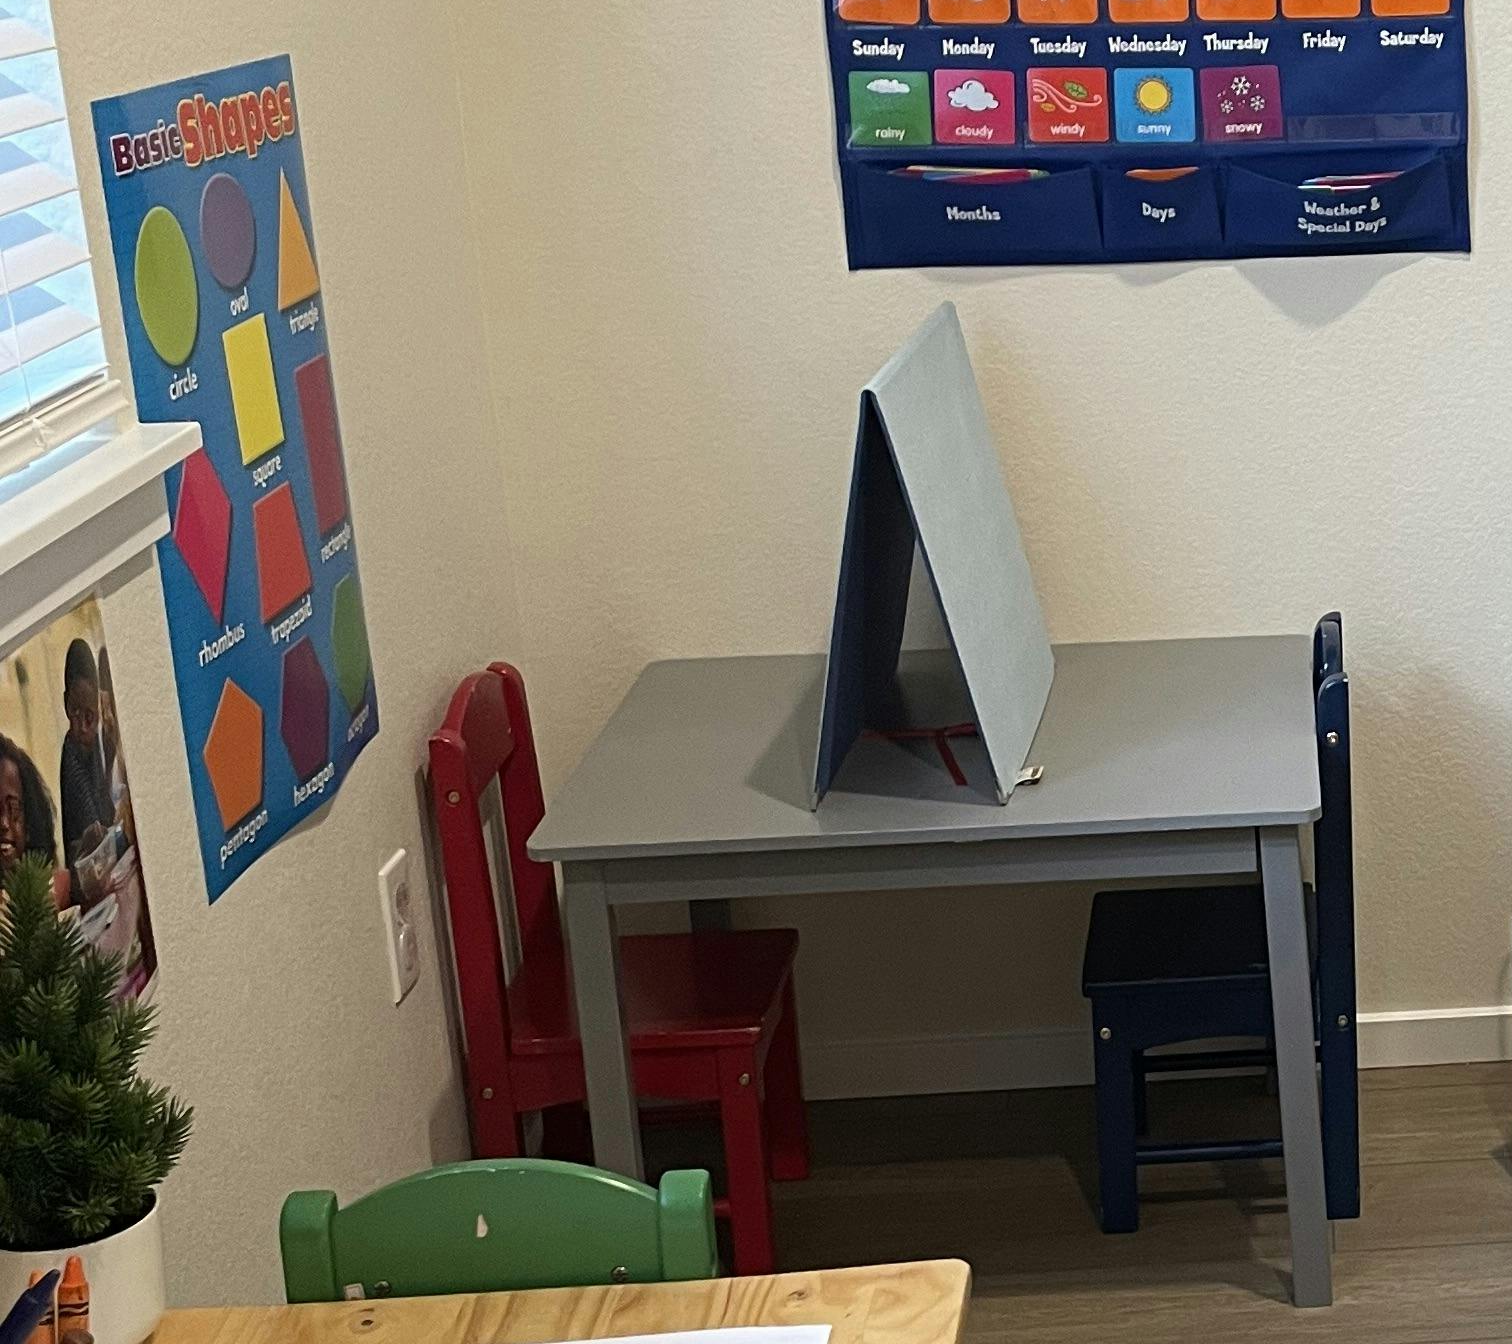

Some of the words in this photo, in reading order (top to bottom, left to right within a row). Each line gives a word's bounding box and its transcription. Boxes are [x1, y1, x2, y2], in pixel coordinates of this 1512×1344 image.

[852, 39, 905, 60] Sunday
[942, 38, 995, 59] Monday
[1030, 38, 1087, 59] Tuesday
[1109, 34, 1187, 56] Wednesday
[1203, 32, 1269, 54] Thursday
[1302, 31, 1347, 51] Friday
[1380, 27, 1444, 48] Saturday
[110, 119, 182, 177] Basic
[177, 81, 296, 167] Shapes
[955, 124, 994, 140] cloudy
[1050, 123, 1085, 138] windy
[1138, 124, 1172, 138] sunny
[1225, 121, 1262, 135] snowy
[946, 205, 1001, 222] Months
[1141, 202, 1177, 223] Days
[1303, 199, 1368, 217] Weather
[1370, 197, 1381, 213] &
[1297, 217, 1352, 235] Special
[1354, 215, 1387, 233] Days
[229, 285, 250, 316] oval
[169, 367, 199, 401] circle
[252, 455, 284, 488] square
[271, 593, 313, 645] trapezoid
[198, 622, 246, 668] rhombus
[293, 761, 335, 807] hexagon
[220, 809, 268, 870] pentagon
